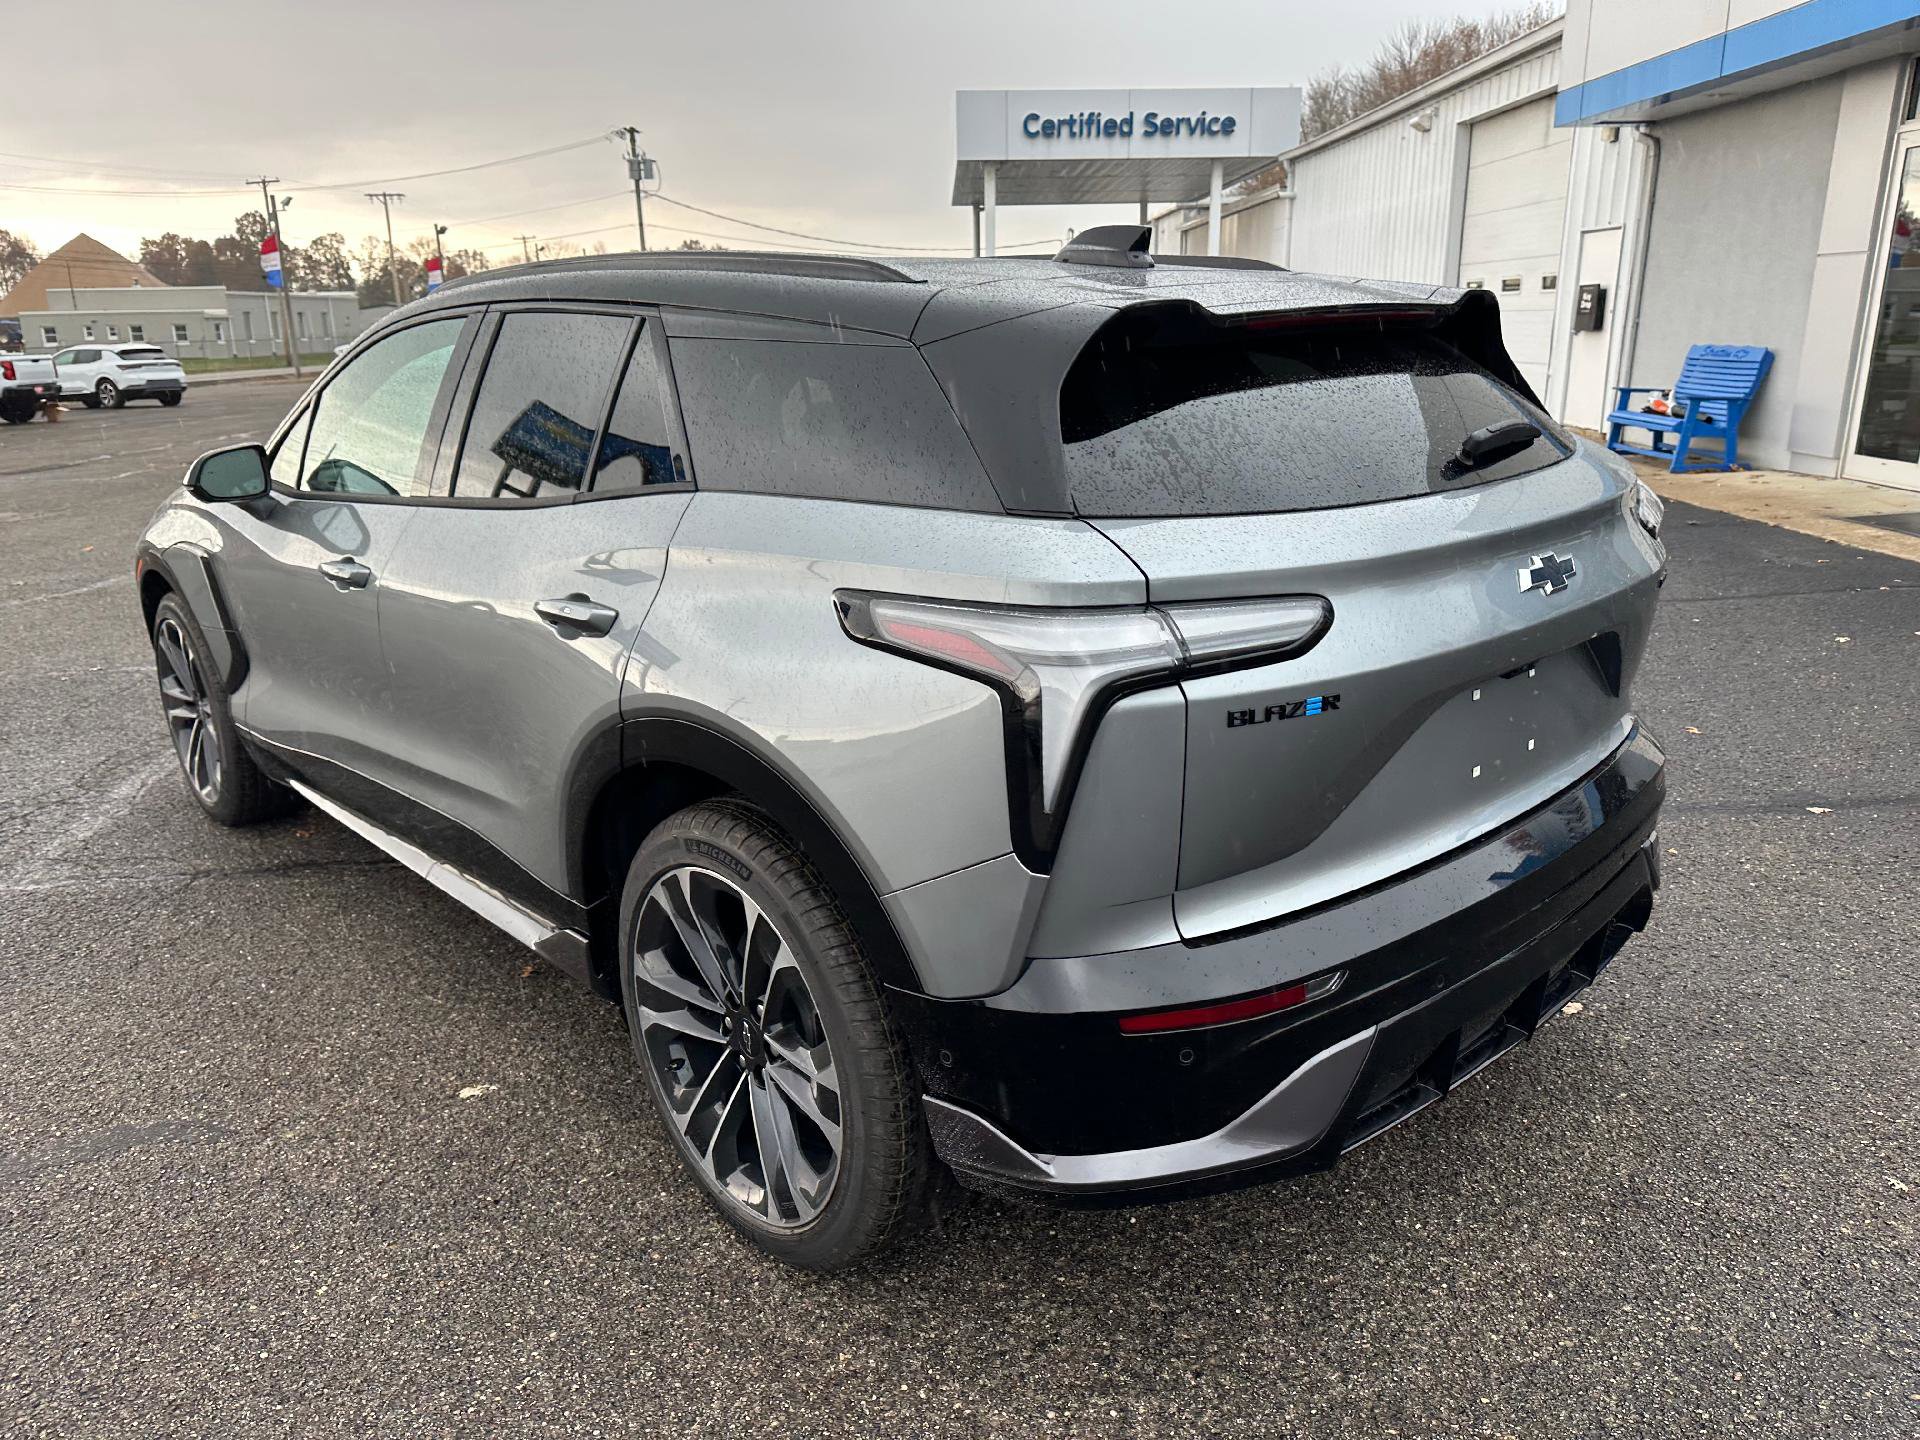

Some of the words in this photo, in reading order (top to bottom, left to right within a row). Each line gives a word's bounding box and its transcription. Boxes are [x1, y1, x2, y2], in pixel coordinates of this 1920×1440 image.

[1022, 111, 1134, 139] Certified
[1143, 111, 1237, 137] Service
[1227, 694, 1341, 728] BLAZER
[699, 843, 750, 878] MICHELIN
